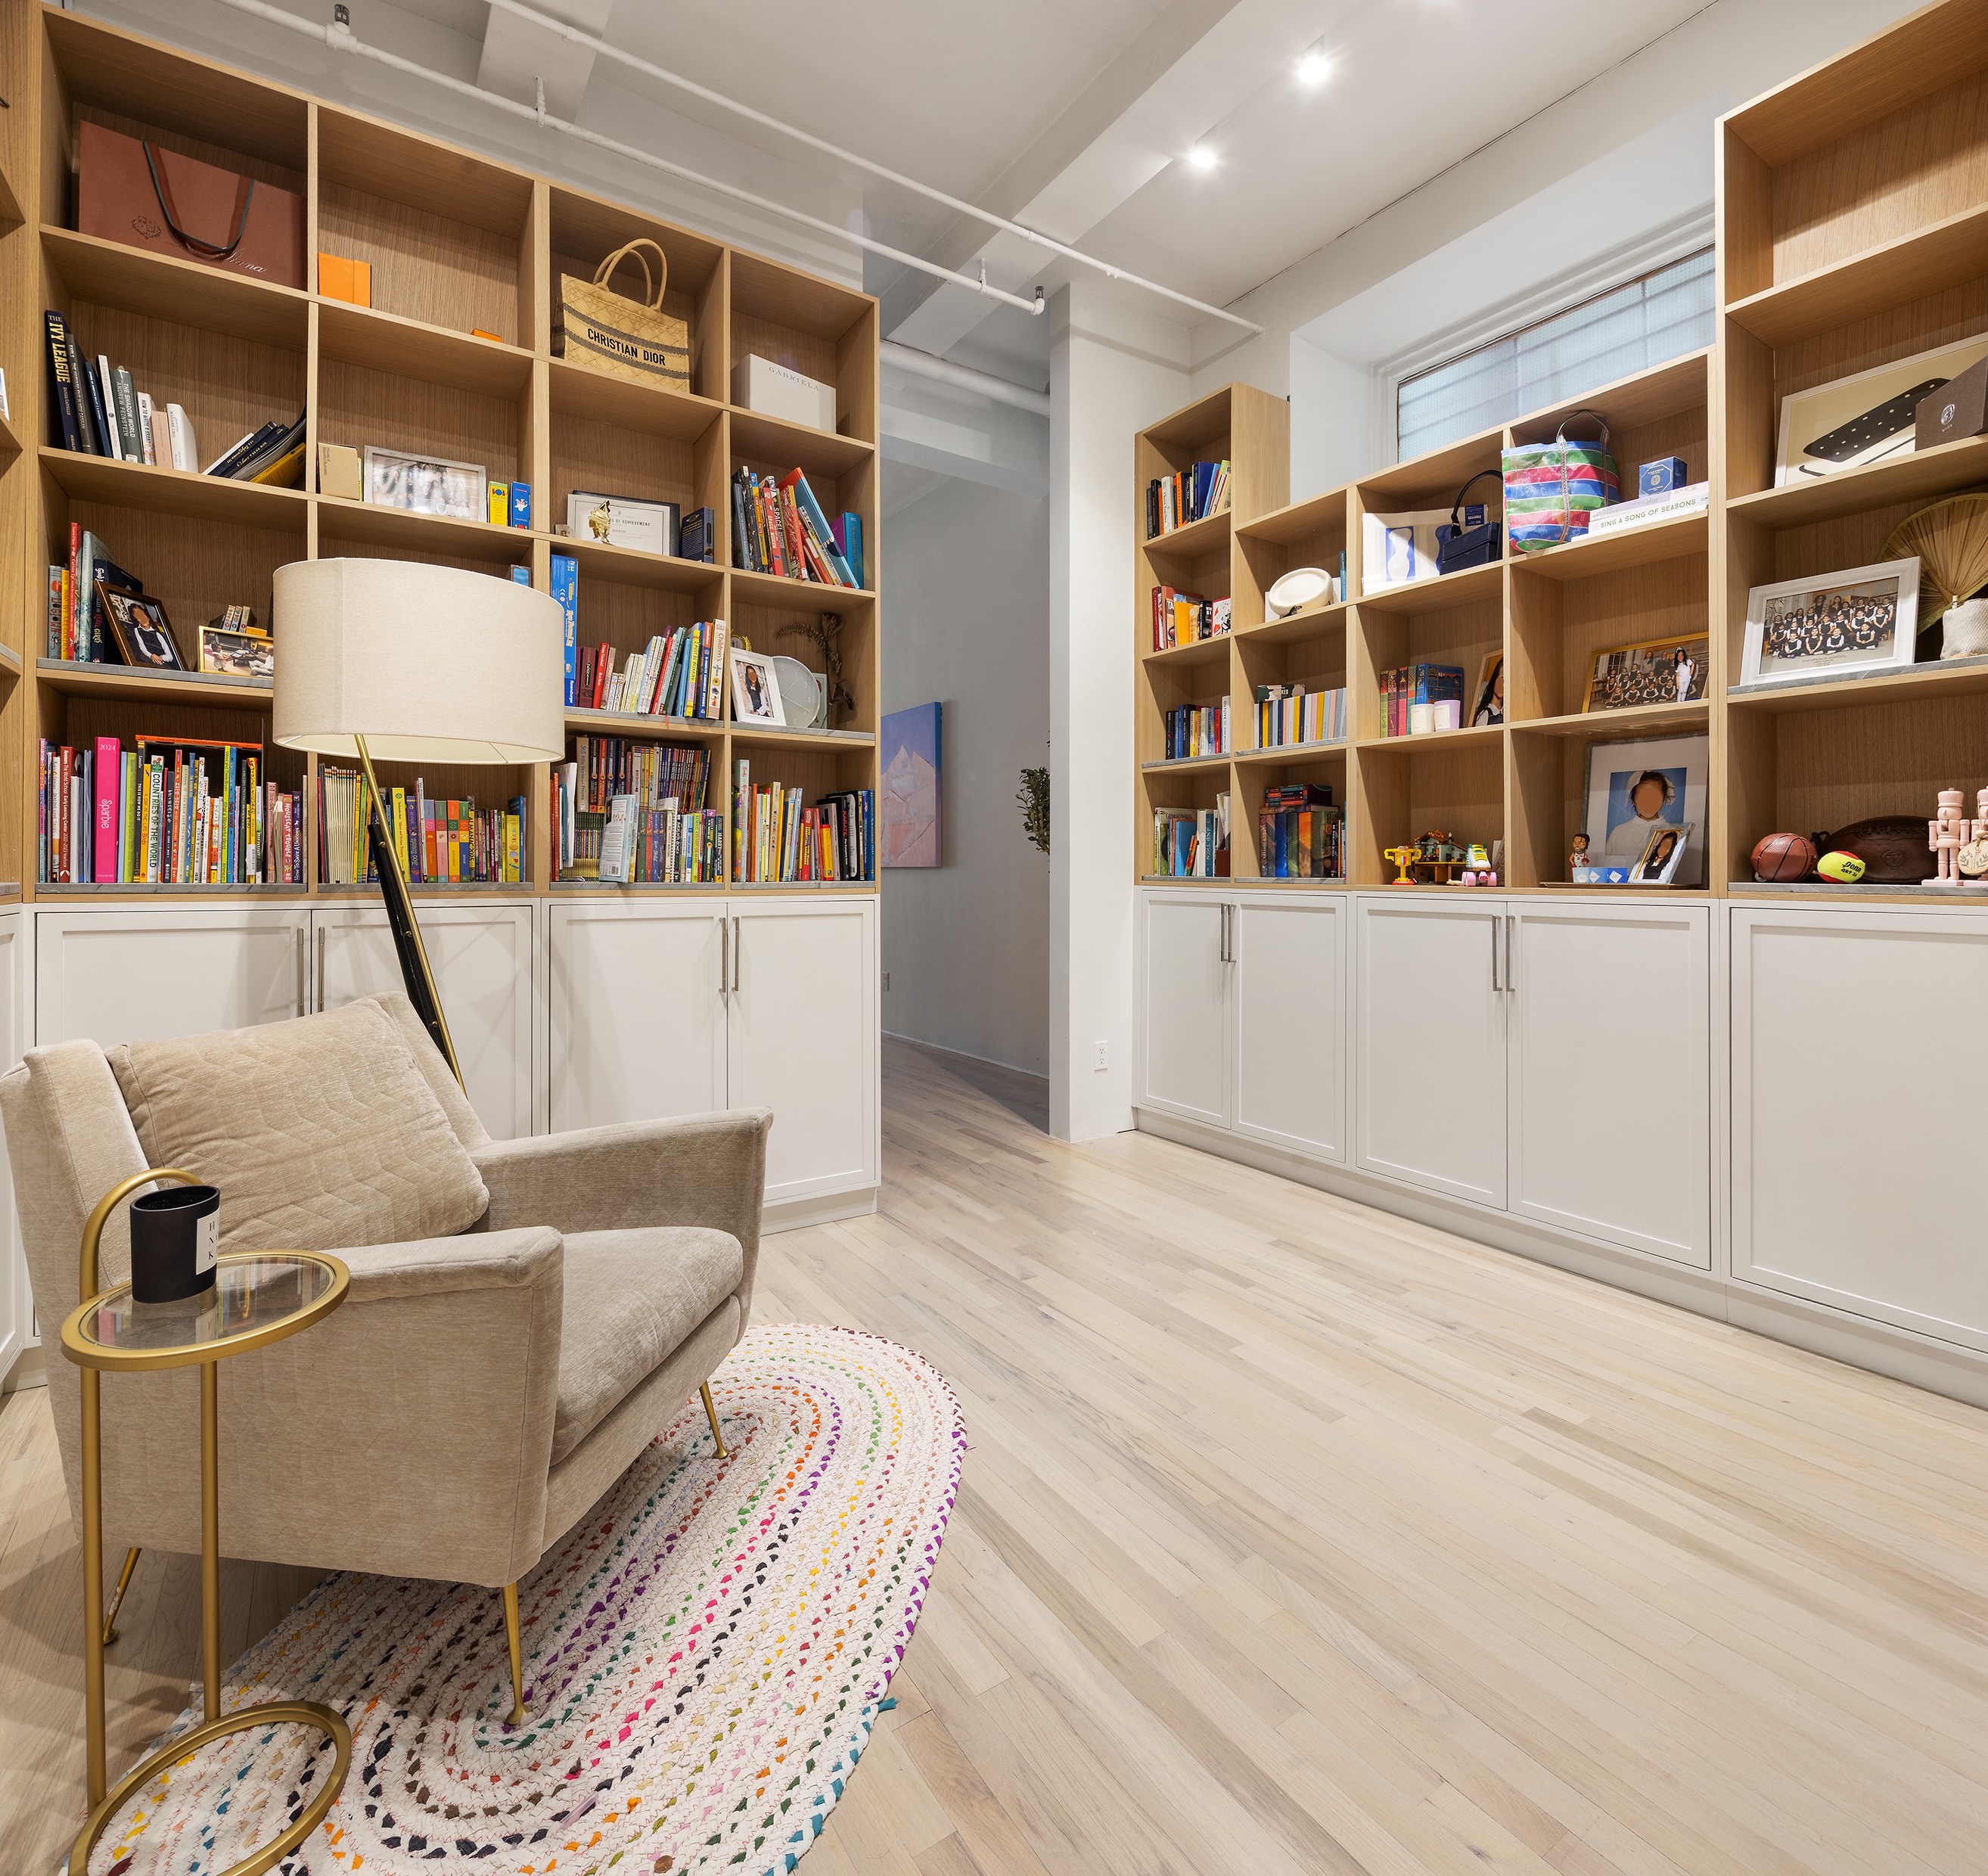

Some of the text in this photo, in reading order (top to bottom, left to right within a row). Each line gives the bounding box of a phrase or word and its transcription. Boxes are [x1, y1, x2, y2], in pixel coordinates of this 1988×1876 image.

[50, 323, 70, 383] IVY LEAGUE
[588, 328, 666, 365] CHRISTIAN DIOR
[769, 367, 818, 391] GABRIELA
[120, 407, 128, 436] FEINSTEIN
[773, 508, 782, 530] SPACE!
[1625, 514, 1645, 522] SONG
[1661, 499, 1696, 512] SEASONS
[51, 598, 61, 632] DOGTOWN
[63, 605, 69, 613] WE
[93, 568, 104, 644] Good REBEL GIRLS
[99, 799, 112, 828] Sparbie
[150, 774, 161, 868] COUNTRIES OF THE WORLD
[1842, 862, 1862, 873] penn
